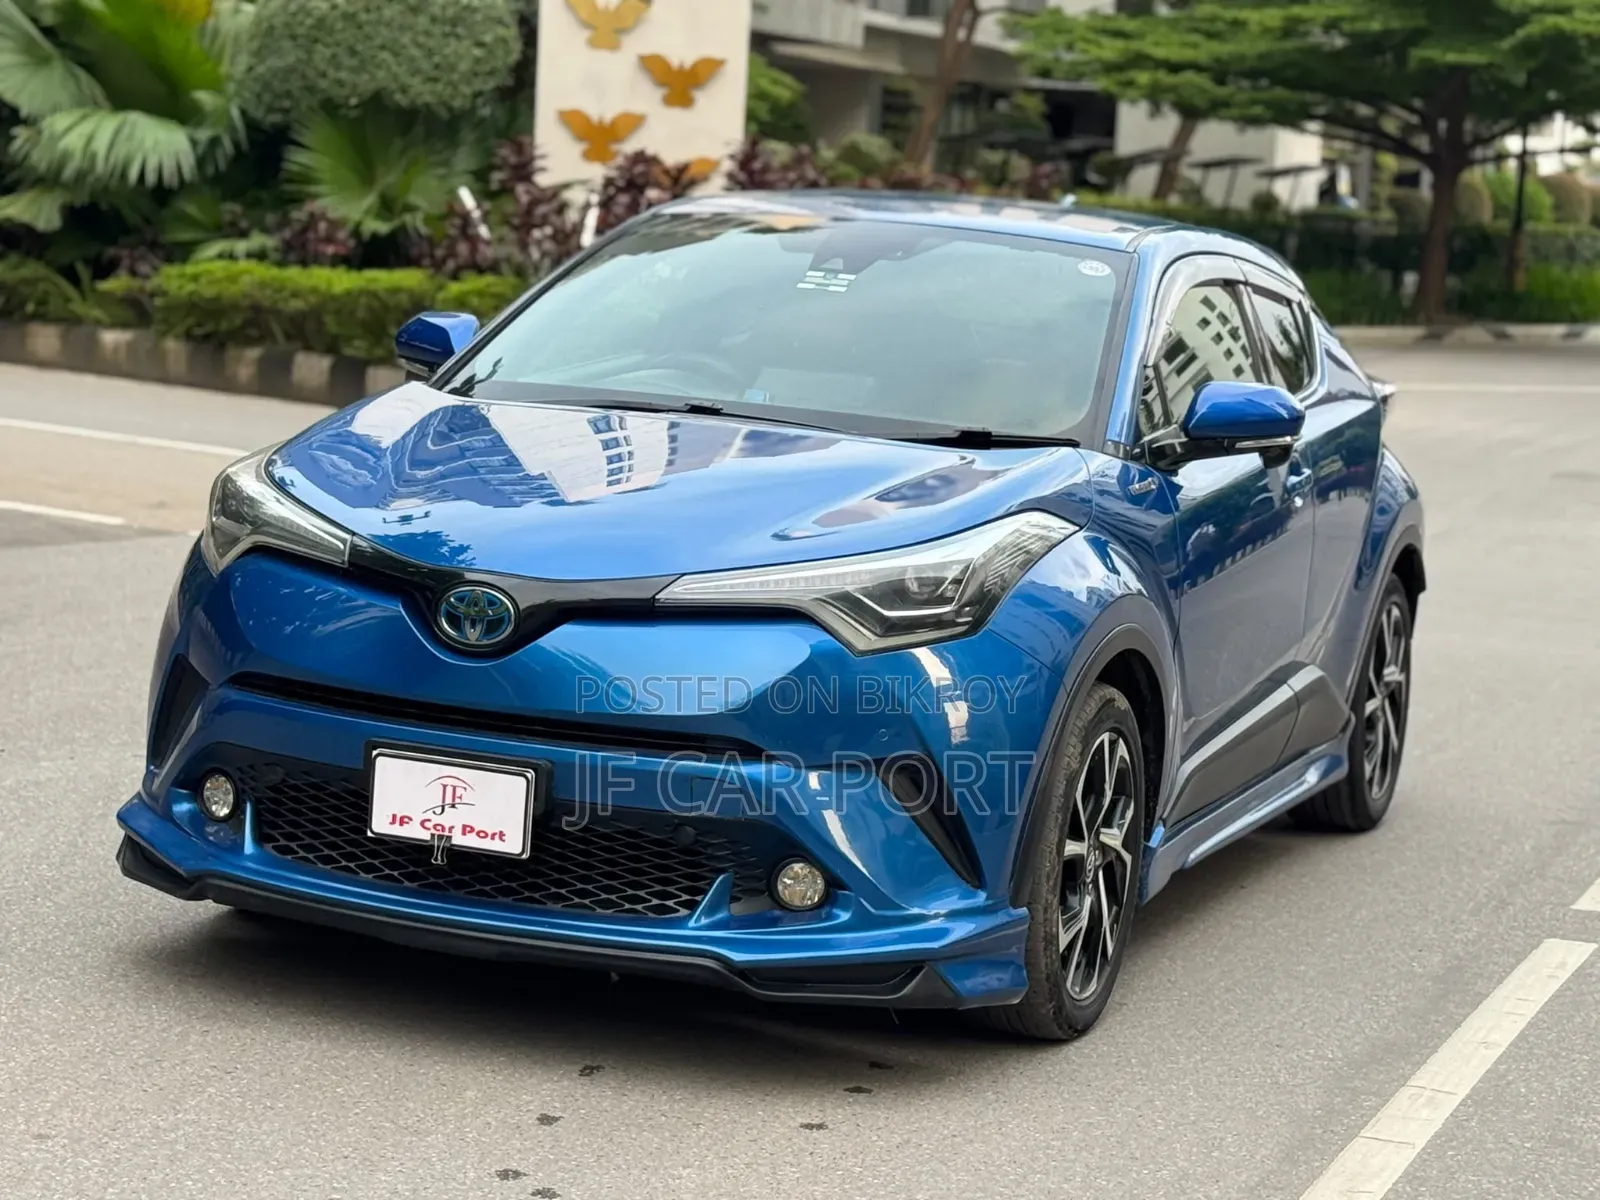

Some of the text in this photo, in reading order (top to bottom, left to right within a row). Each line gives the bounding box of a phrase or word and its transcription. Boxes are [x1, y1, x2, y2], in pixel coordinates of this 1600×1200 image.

[432, 783, 467, 816] JF
[388, 813, 507, 843] JF Car Port
